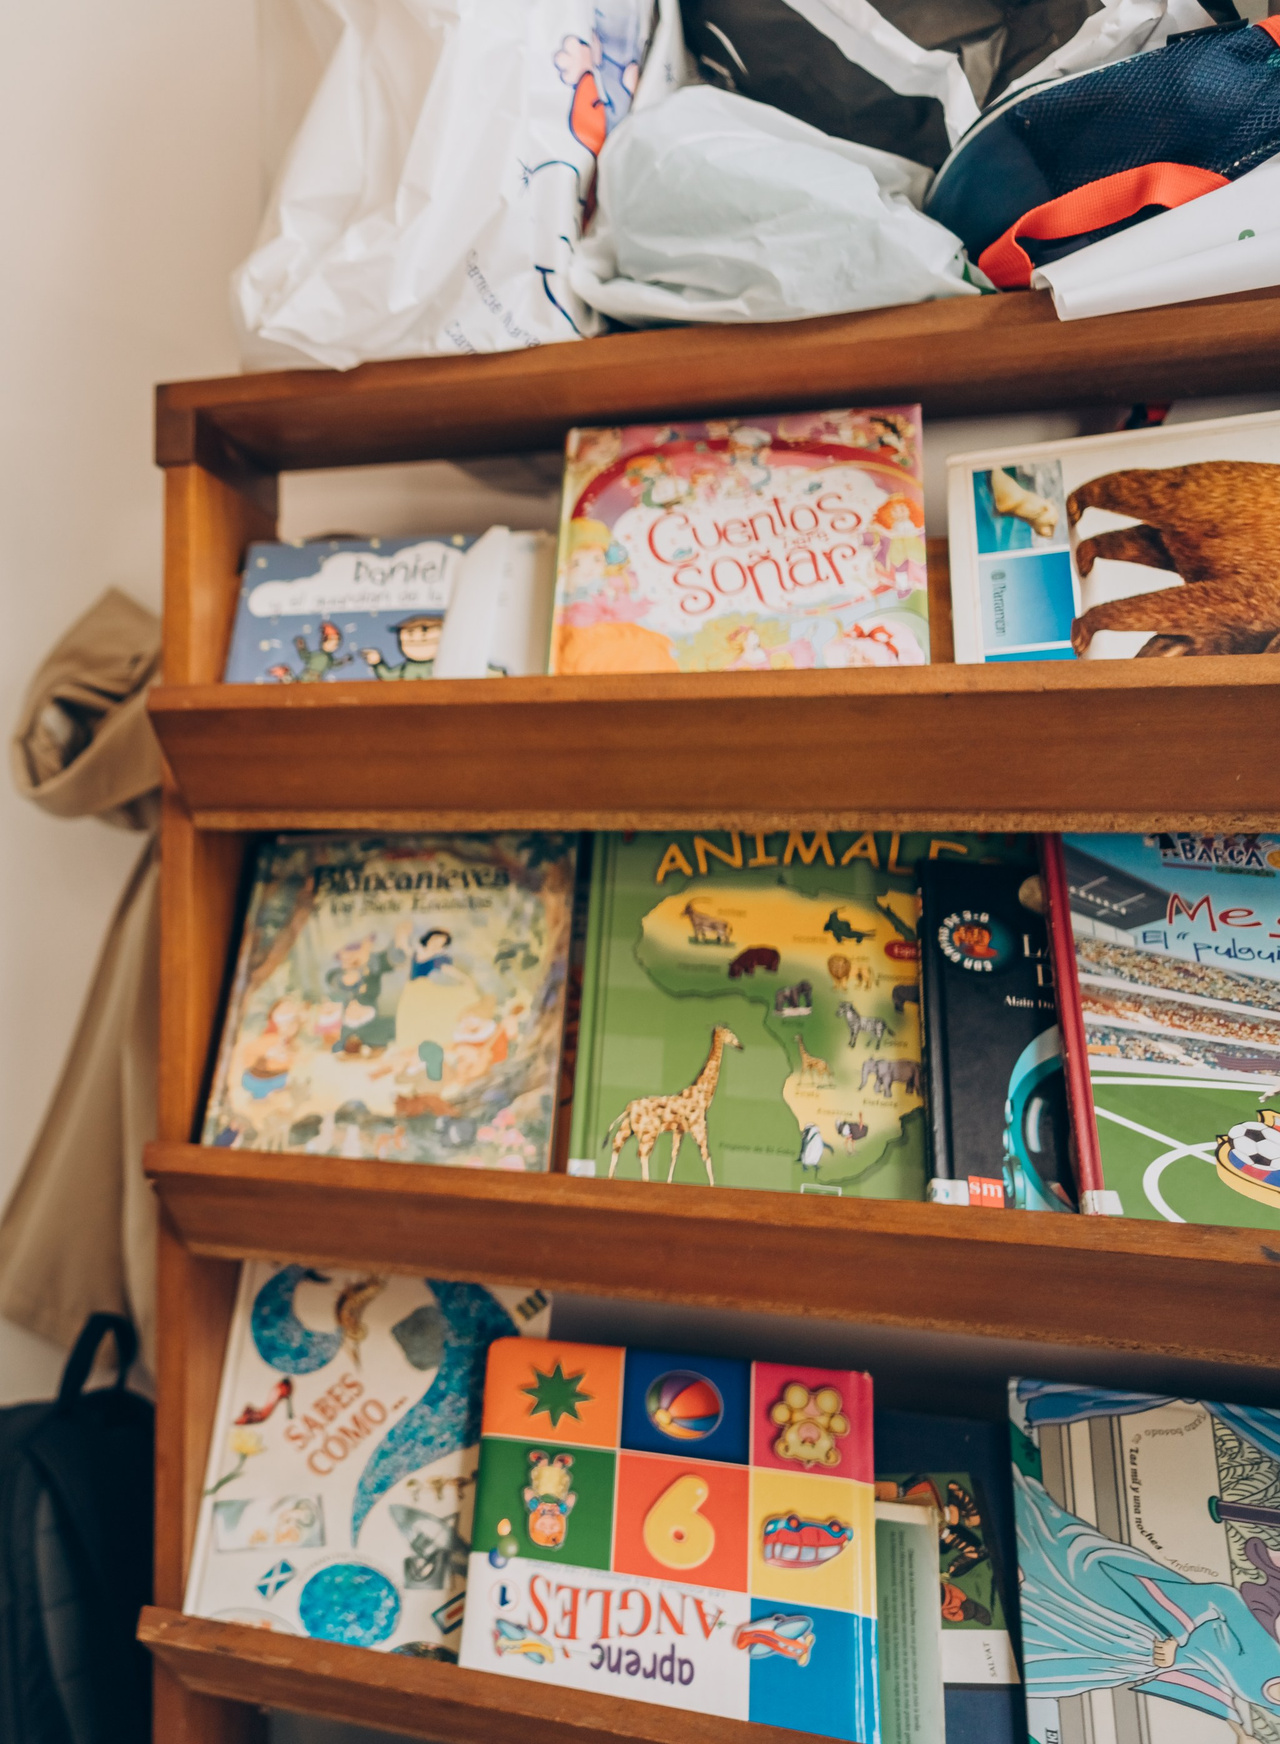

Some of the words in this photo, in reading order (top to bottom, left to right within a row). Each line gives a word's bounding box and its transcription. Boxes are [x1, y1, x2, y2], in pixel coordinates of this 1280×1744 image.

[647, 491, 862, 566] Cuentos
[673, 543, 857, 616] soñar
[1166, 892, 1280, 932] Me
[1142, 930, 1169, 950] El
[969, 1181, 1004, 1198] sm
[283, 1371, 365, 1454] SABES
[1129, 1485, 1140, 1494] y
[1130, 1468, 1142, 1486] mil
[1133, 1495, 1142, 1514] una
[589, 1641, 696, 1687] aprenc
[982, 1641, 998, 1678] SALVAT
